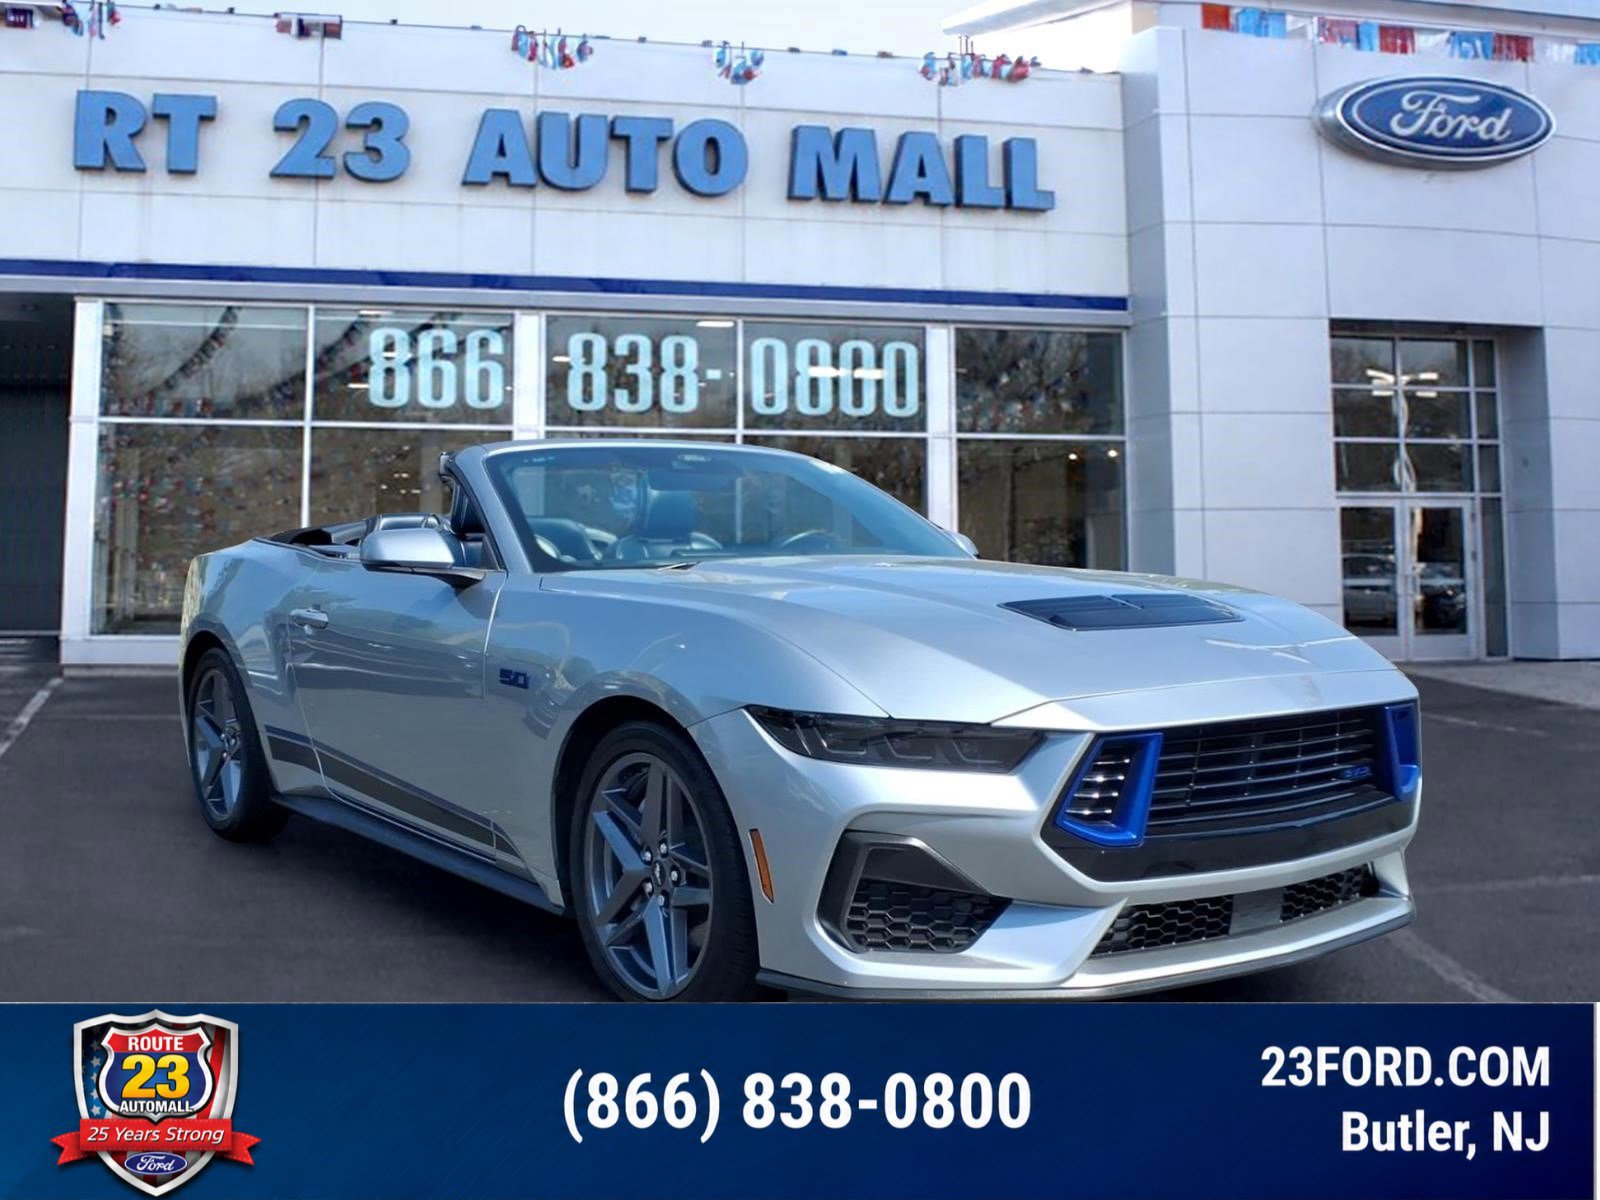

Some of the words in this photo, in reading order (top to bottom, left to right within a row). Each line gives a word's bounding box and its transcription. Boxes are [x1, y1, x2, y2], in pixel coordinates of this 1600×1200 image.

[73, 89, 217, 174] RT
[269, 98, 411, 182] 23
[462, 108, 749, 197] AUTO
[787, 125, 1056, 212] MALL
[1390, 90, 1512, 142] Ford
[368, 327, 504, 409] 866
